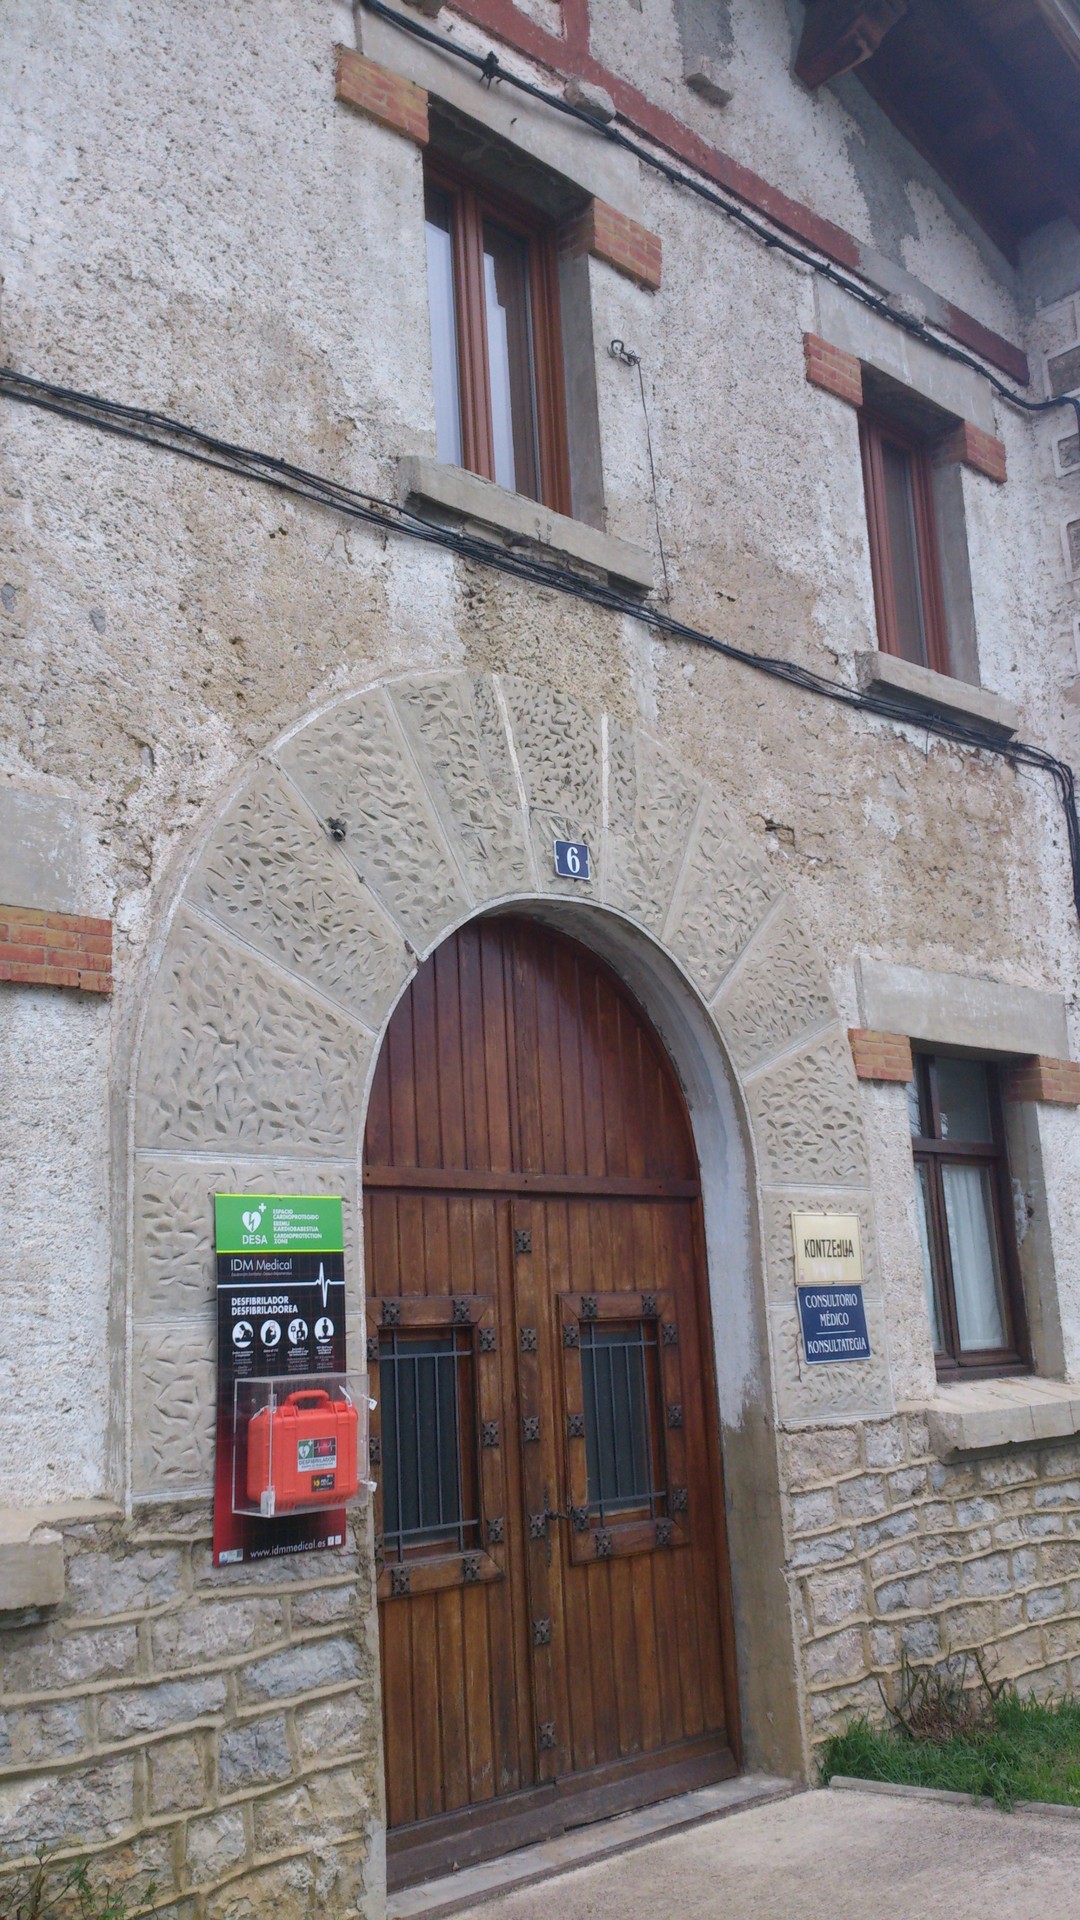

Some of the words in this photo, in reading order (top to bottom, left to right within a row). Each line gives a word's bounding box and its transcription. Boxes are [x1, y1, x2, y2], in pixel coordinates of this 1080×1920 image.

[567, 847, 580, 873] 6
[242, 1234, 268, 1245] DESA
[804, 1239, 854, 1258] KONTZEJUA
[230, 1259, 254, 1271] IDM
[256, 1258, 292, 1270] Medical
[231, 1296, 289, 1306] DESFIBRILADOR
[805, 1293, 858, 1308] CONSULTORIO
[231, 1305, 298, 1316] DESFIBRILADOREA
[820, 1311, 849, 1327] MÉDICO
[808, 1337, 867, 1354] KONSULTATEGIA
[299, 1457, 335, 1465] DESFIBRILADOR
[250, 1539, 326, 1558] www.idmmedical.es
